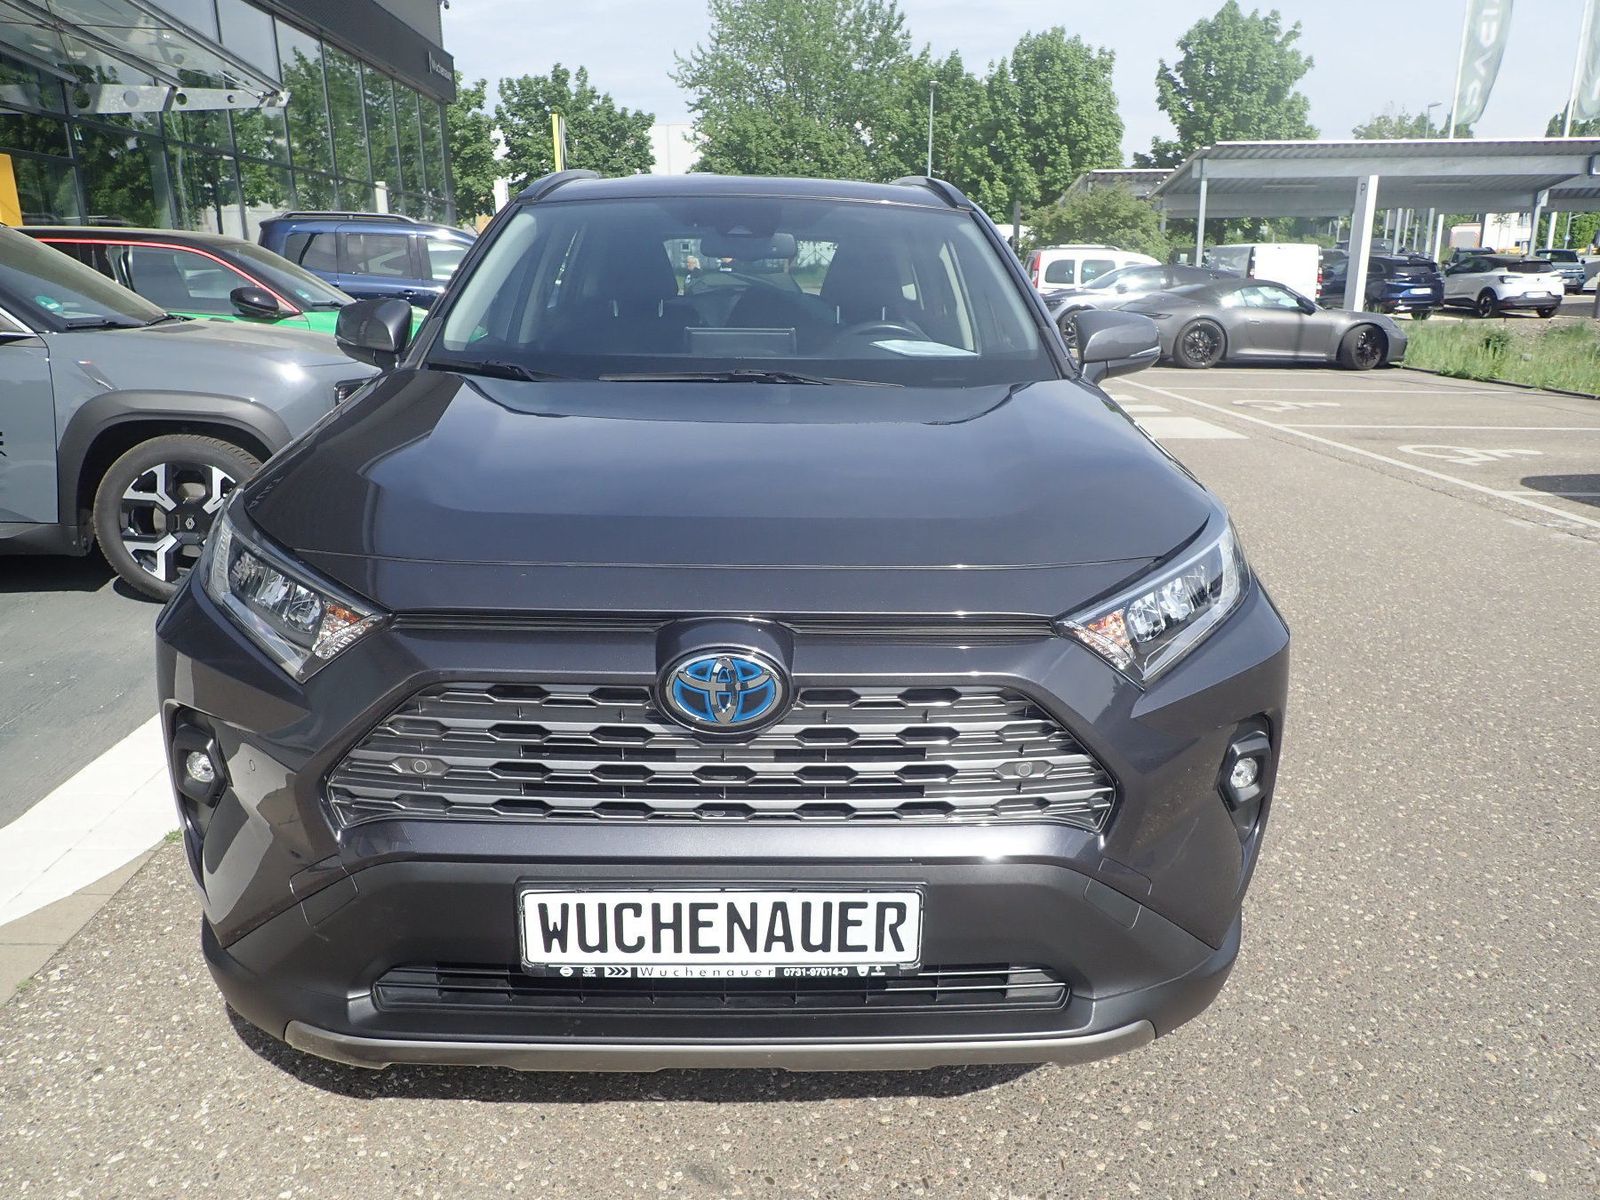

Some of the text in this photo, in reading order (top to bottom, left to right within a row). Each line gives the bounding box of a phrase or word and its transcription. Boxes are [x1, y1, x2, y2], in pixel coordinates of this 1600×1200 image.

[537, 901, 908, 955] WUCHENAUER
[639, 966, 849, 978] Wuchenauer 0731-97014-0
